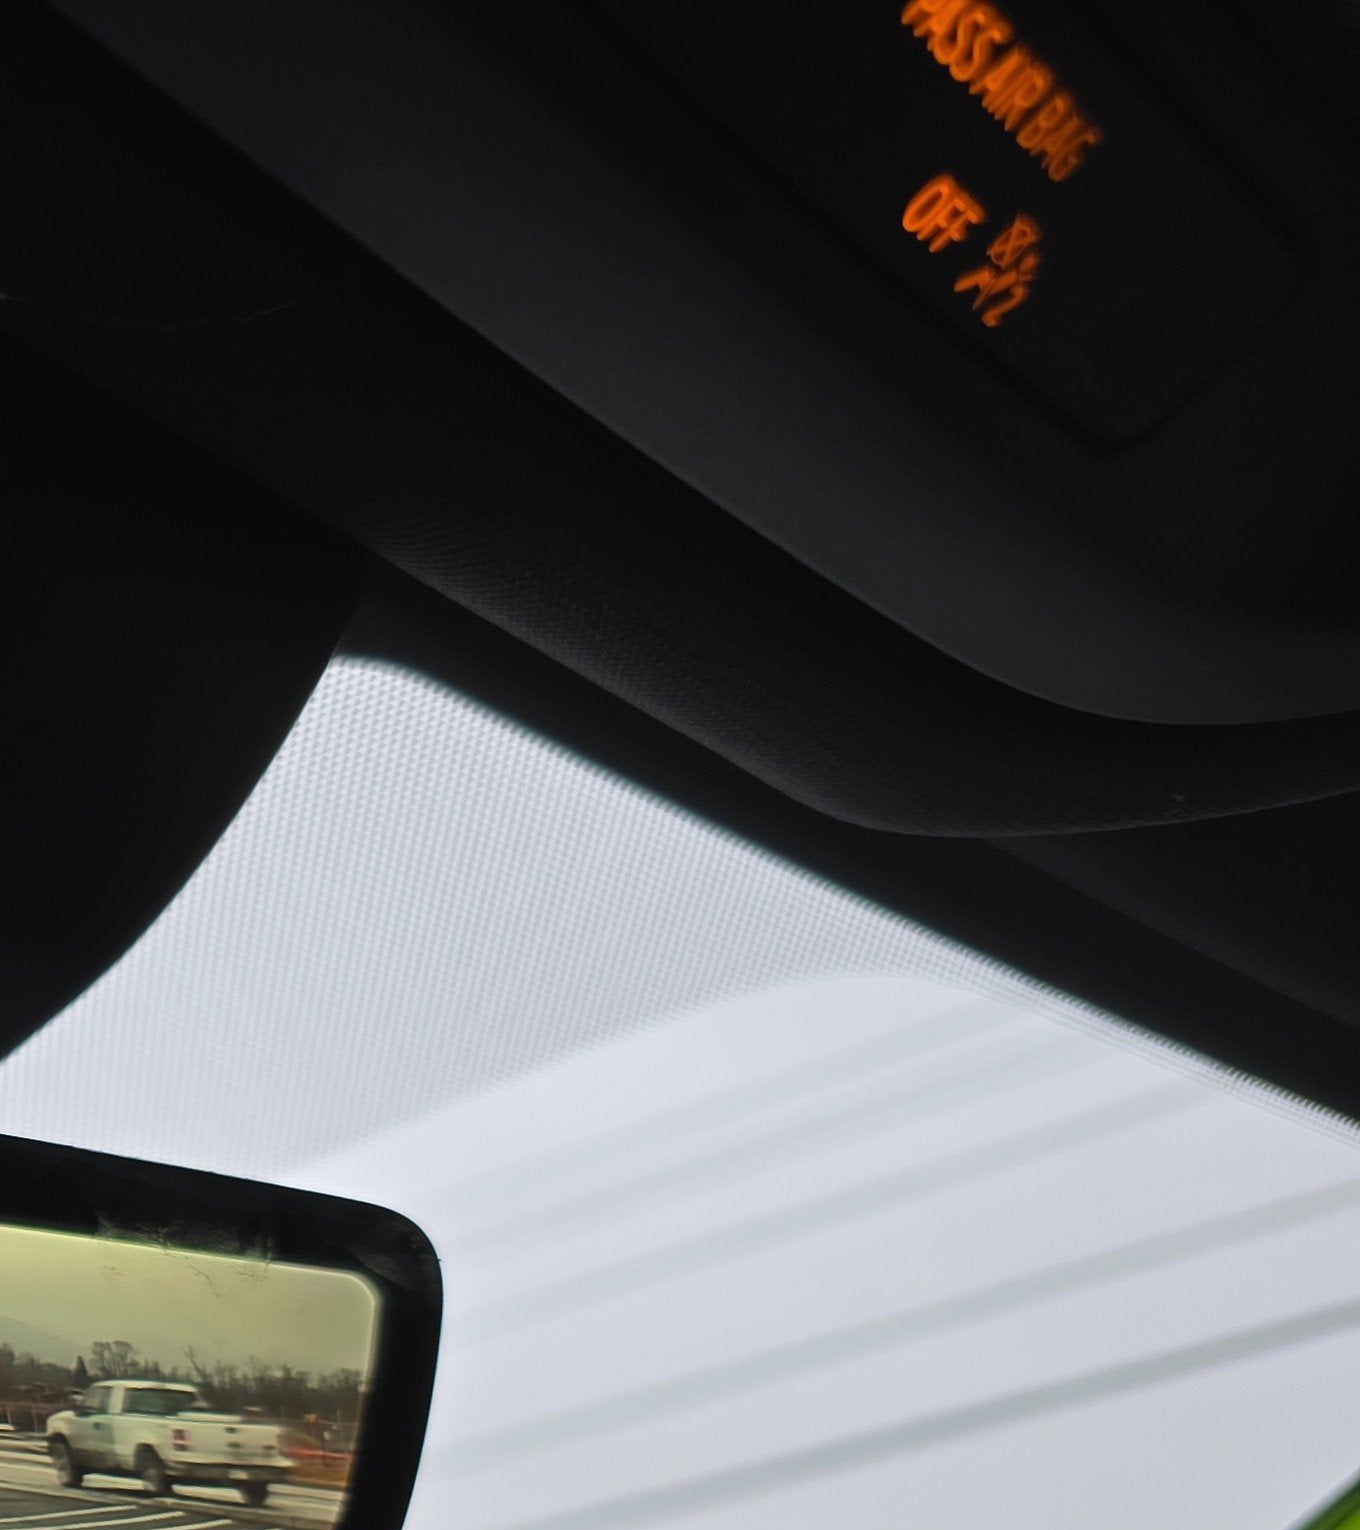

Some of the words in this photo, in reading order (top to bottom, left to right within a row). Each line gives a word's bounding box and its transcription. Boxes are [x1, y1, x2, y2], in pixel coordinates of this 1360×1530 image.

[968, 46, 1055, 131] AIR
[1016, 92, 1102, 182] BAG
[902, 174, 986, 253] OFF
